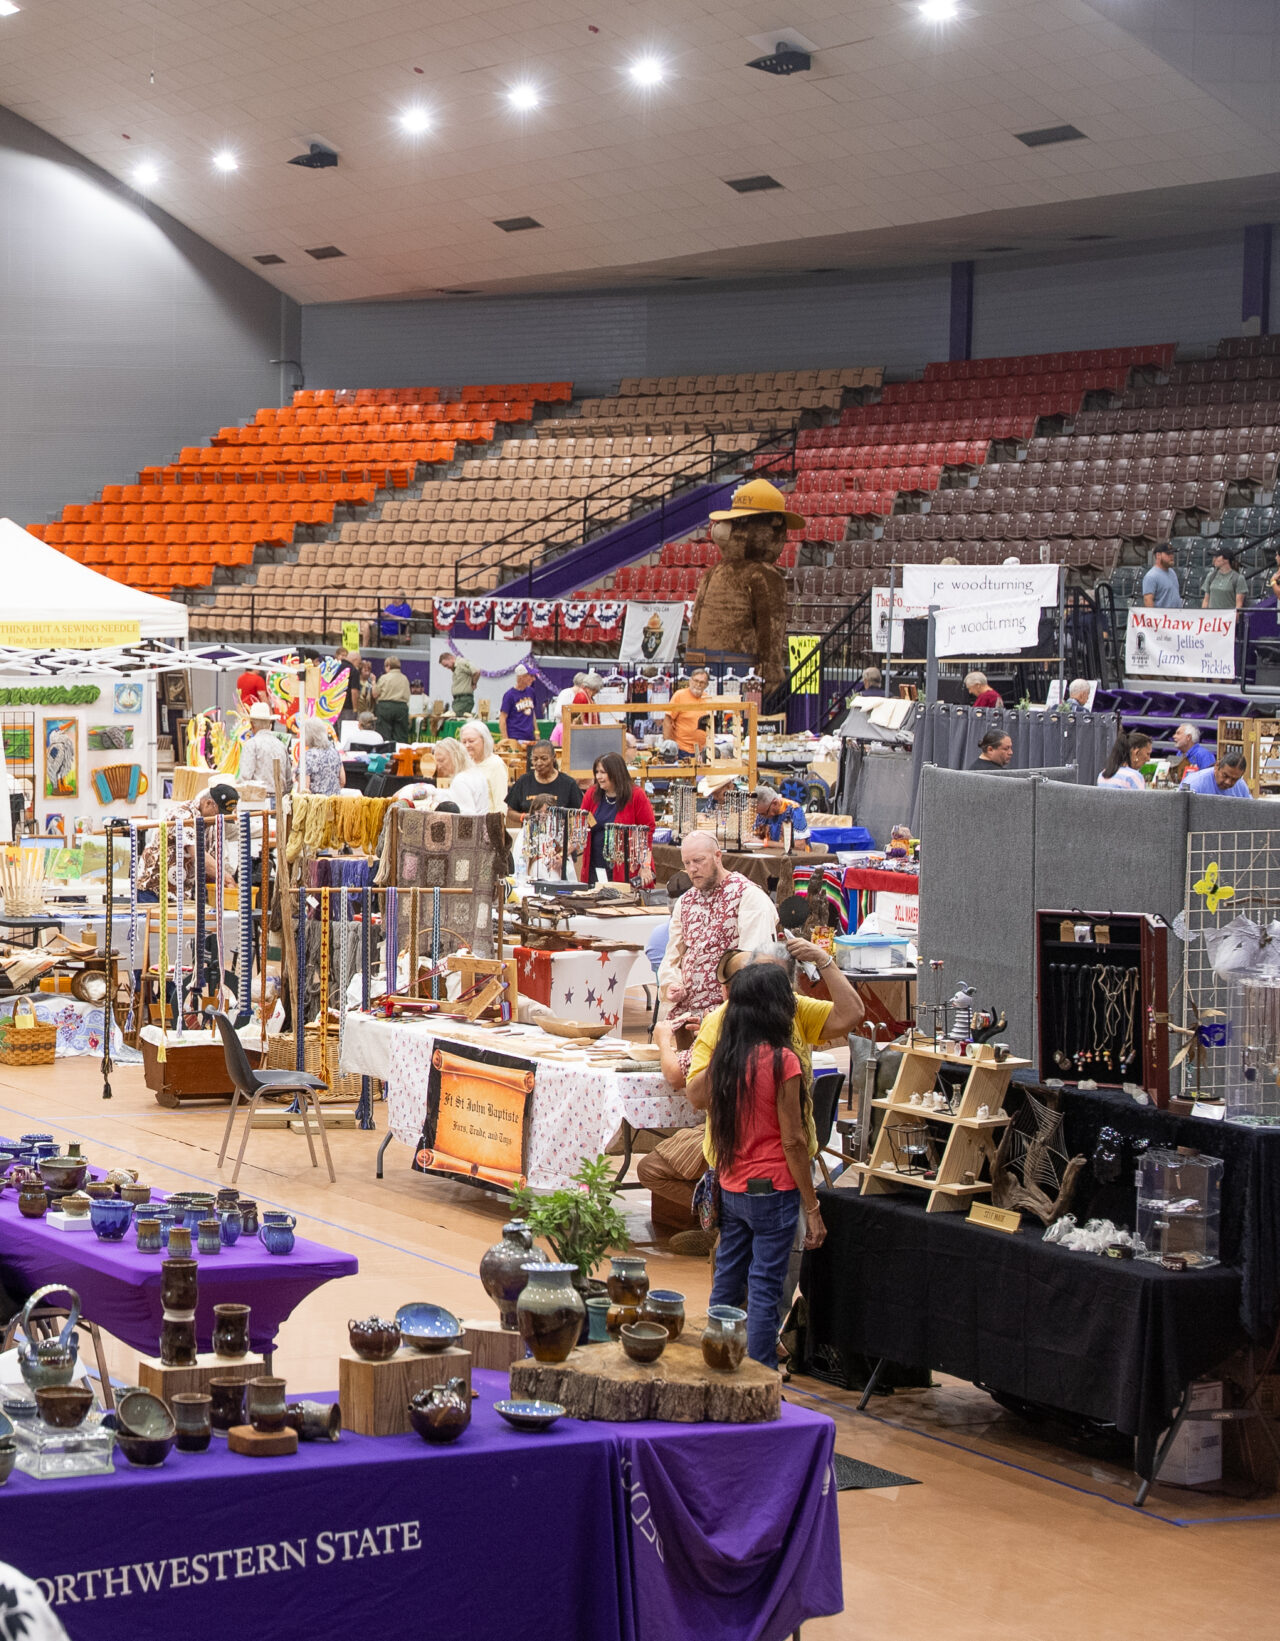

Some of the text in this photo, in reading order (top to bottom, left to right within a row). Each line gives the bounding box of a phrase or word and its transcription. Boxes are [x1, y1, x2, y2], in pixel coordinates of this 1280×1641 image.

[932, 574, 1034, 598] je woodturning
[32, 624, 53, 633] BUT
[53, 624, 61, 633] A
[62, 624, 100, 634] SEWING
[101, 623, 138, 633] NEEDLE
[1131, 613, 1232, 637] Mayhaw Jelly
[26, 636, 37, 644] Art
[1176, 634, 1205, 652] Jellies
[1157, 650, 1185, 668] Jams
[1201, 659, 1231, 674] Pickles
[455, 1095, 465, 1109] St
[466, 1098, 486, 1116] John
[487, 1103, 519, 1124] Baptiste
[487, 1130, 498, 1141] and
[34, 1520, 422, 1607] ORTHWESTERN STATE
